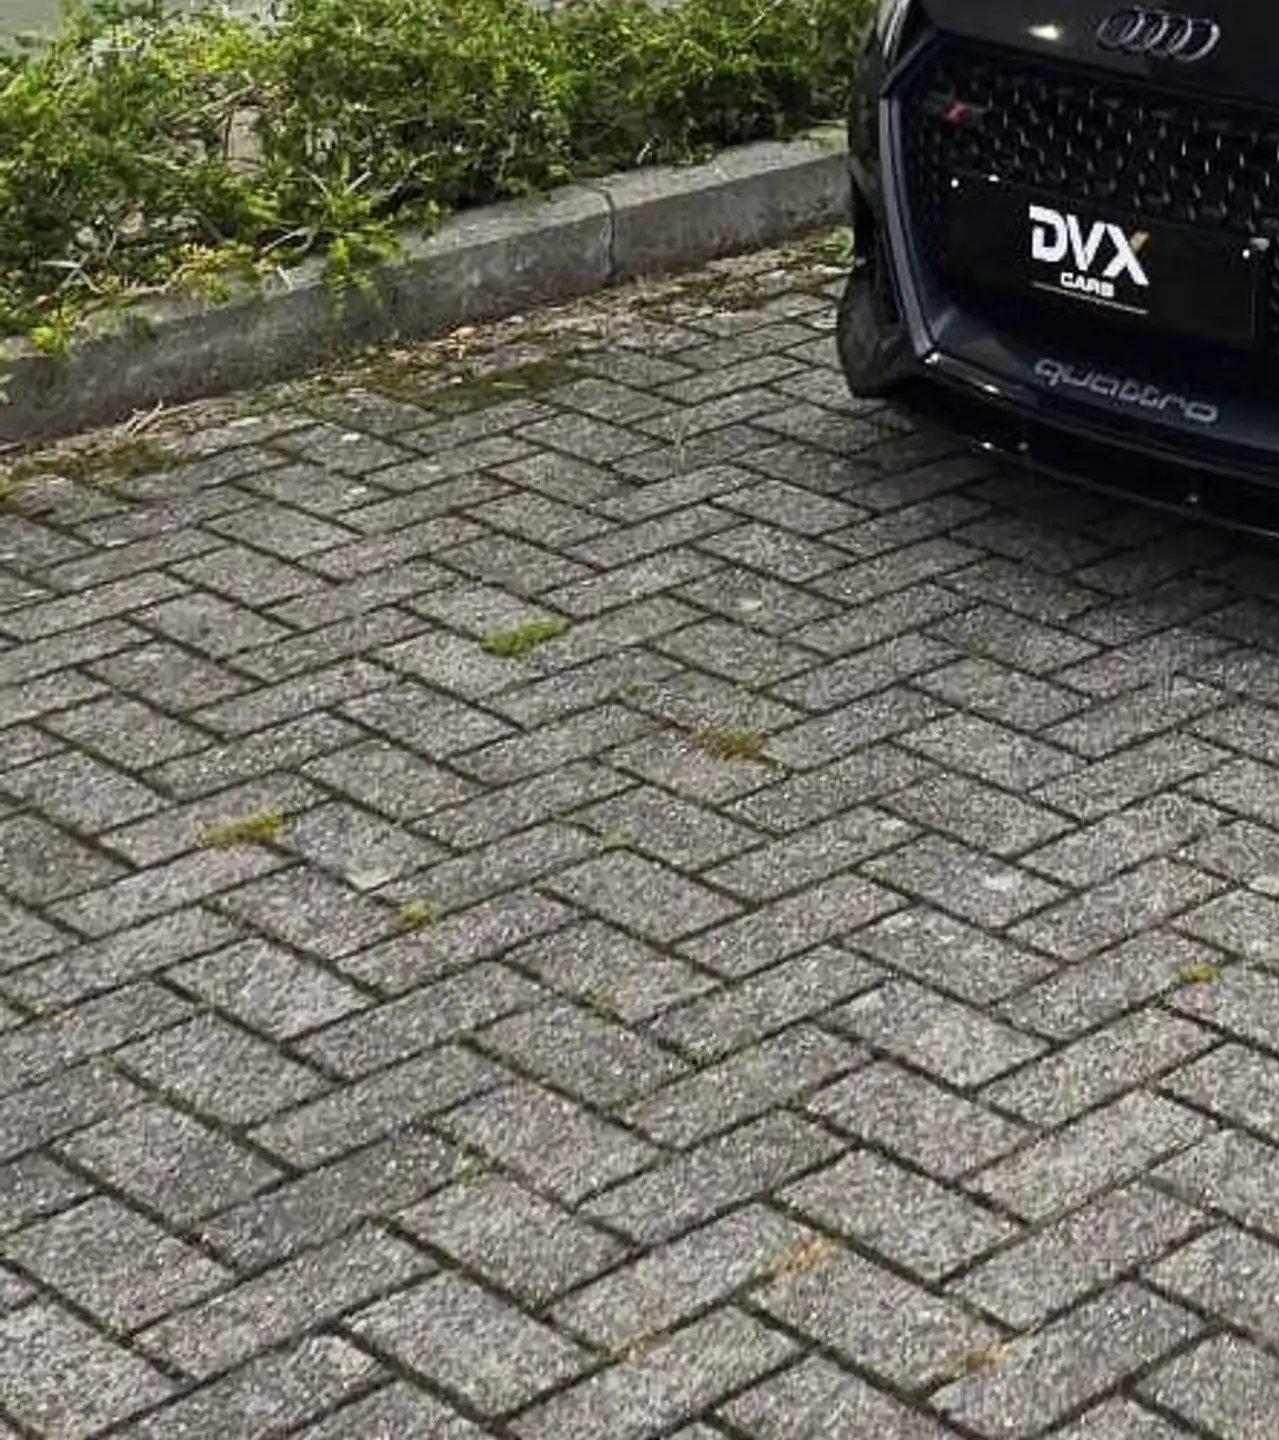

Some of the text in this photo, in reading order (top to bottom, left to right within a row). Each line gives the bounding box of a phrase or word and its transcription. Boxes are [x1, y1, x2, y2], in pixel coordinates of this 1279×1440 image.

[1029, 203, 1150, 286] DVX
[1060, 271, 1115, 298] CARS
[1034, 358, 1219, 423] quattro
